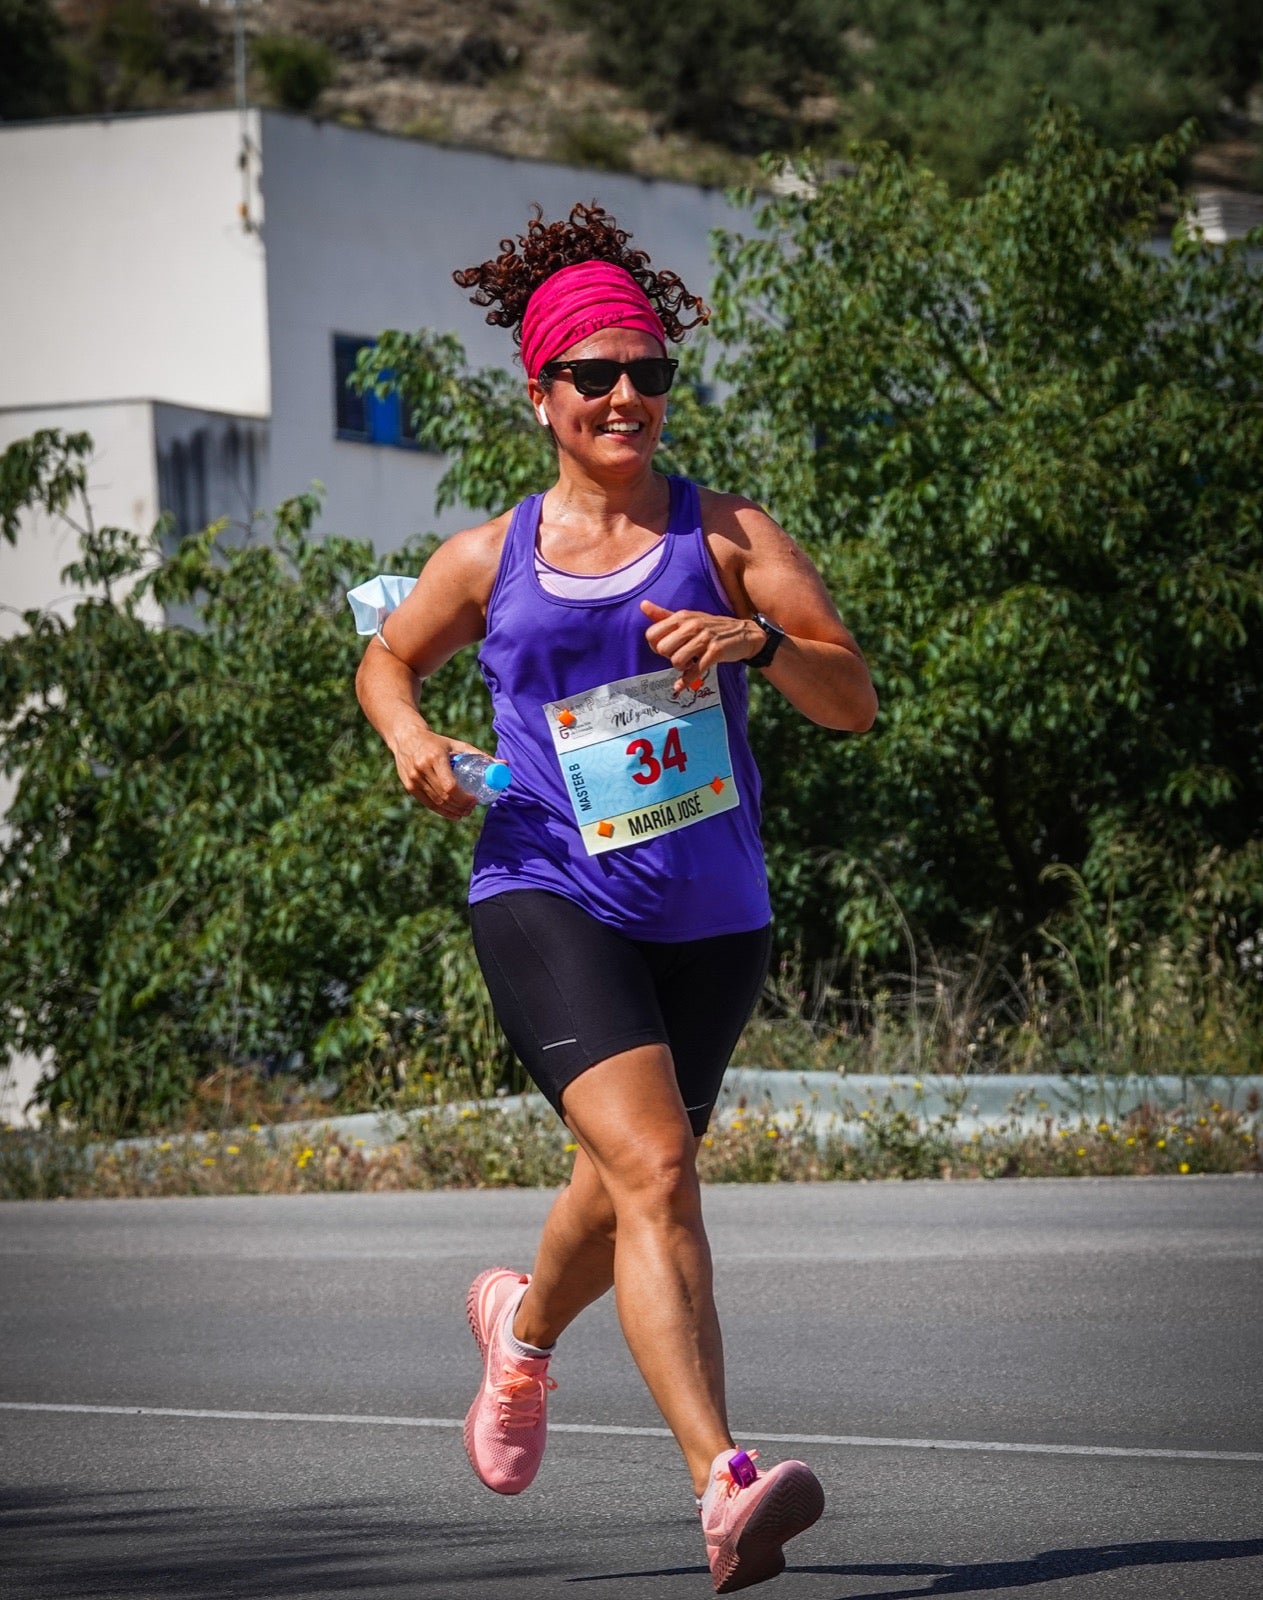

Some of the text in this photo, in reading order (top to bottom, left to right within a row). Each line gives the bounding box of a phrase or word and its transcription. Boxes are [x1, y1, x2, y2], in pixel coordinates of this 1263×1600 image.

[625, 726, 688, 786] 34
[569, 763, 593, 812] MASTER B
[628, 792, 704, 836] MARÍA JOSÉ
